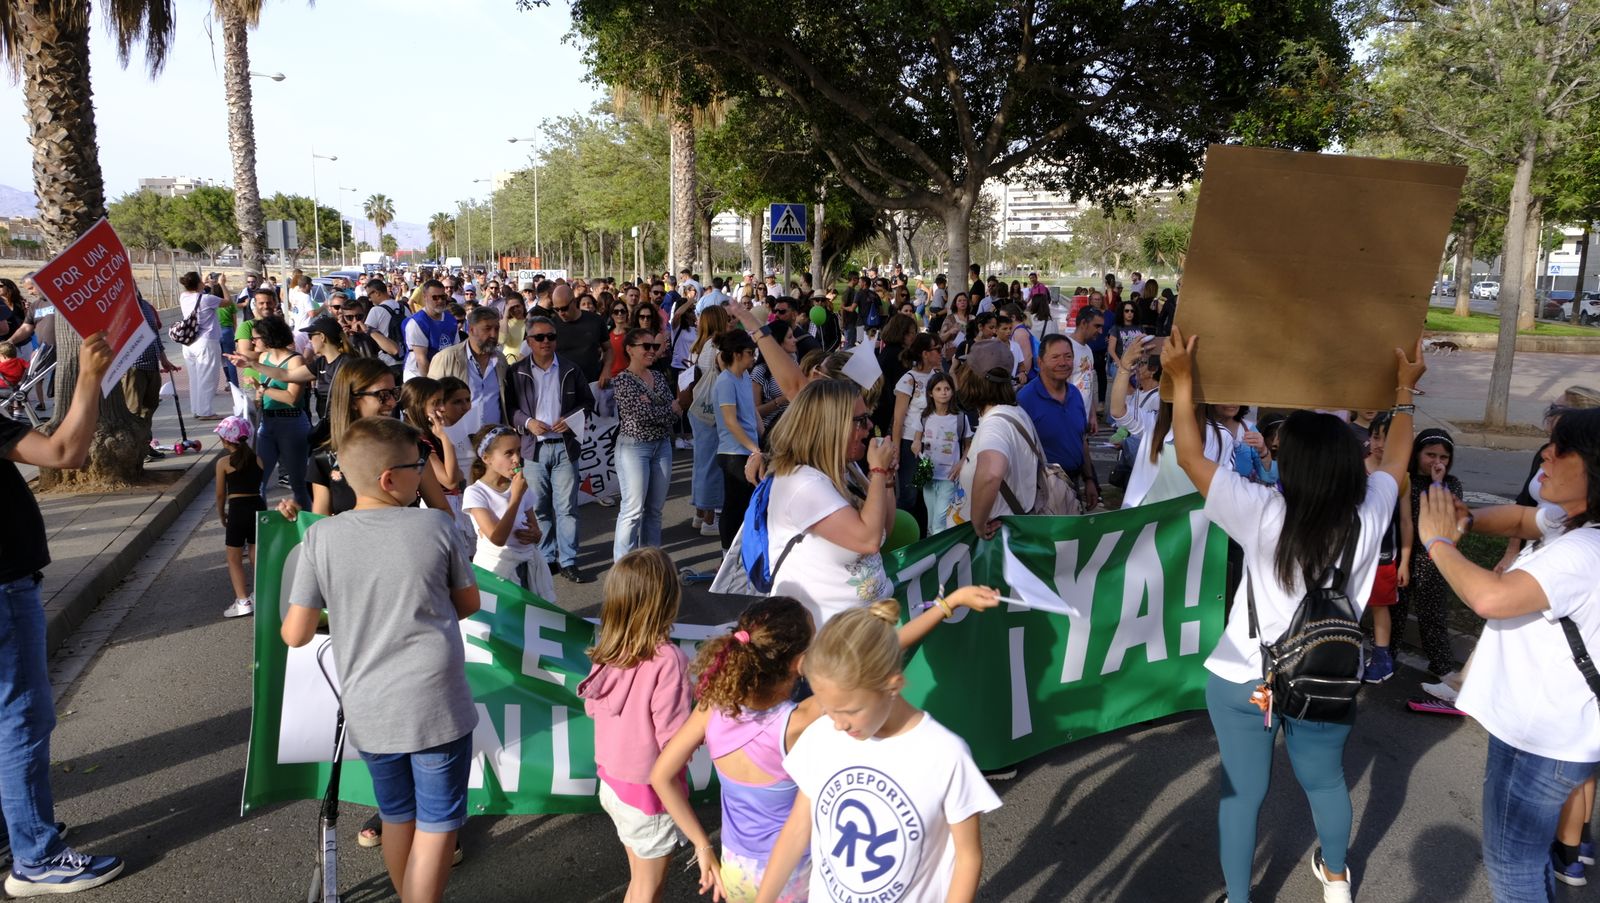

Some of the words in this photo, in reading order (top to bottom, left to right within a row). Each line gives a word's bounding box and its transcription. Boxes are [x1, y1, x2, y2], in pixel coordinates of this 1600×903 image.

[52, 265, 83, 292] POR
[84, 243, 108, 268] UNA
[63, 252, 125, 311] EDUCACIÓN
[95, 277, 125, 314] DIGNA
[820, 779, 843, 816] CLUB
[845, 772, 921, 842] DEPORTIVO
